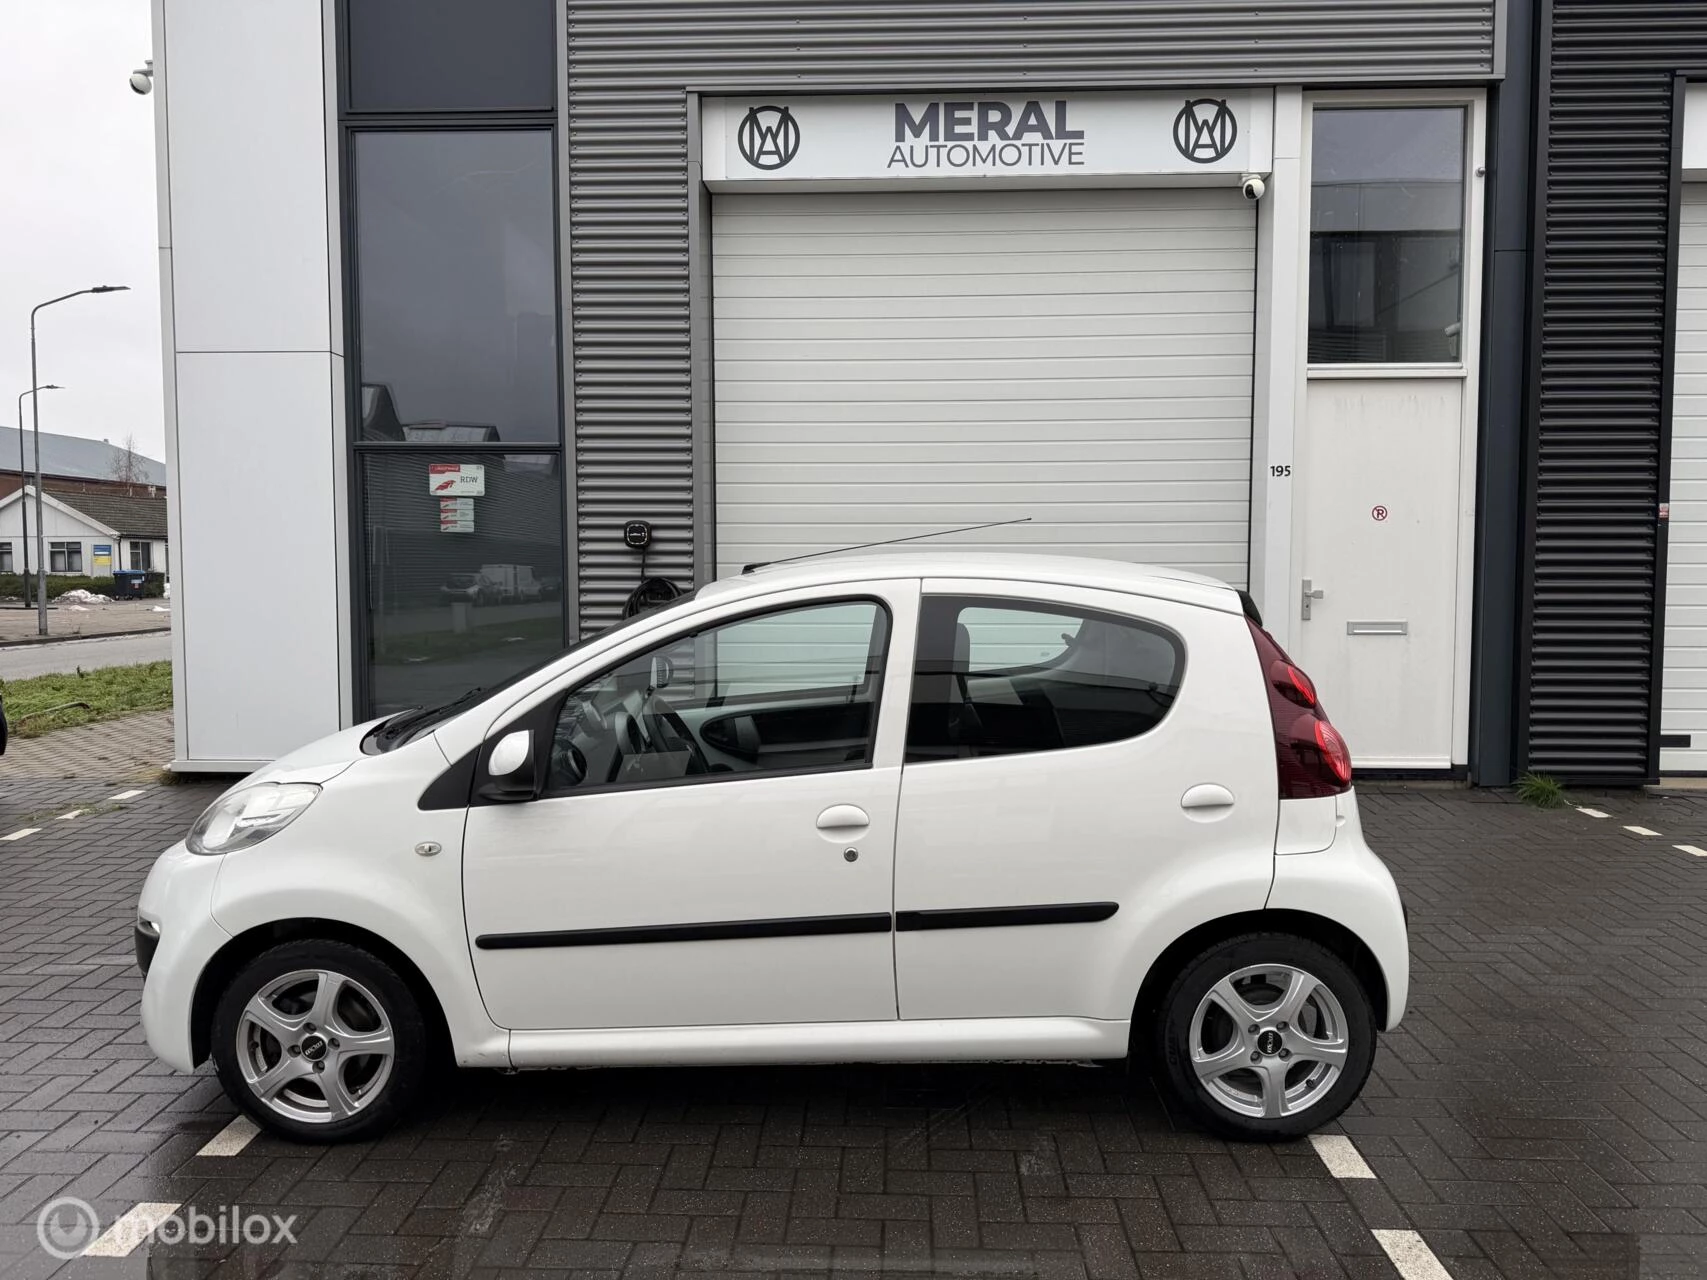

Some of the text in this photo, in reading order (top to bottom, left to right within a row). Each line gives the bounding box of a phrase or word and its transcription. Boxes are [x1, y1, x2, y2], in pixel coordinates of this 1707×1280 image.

[895, 100, 1085, 142] MERAL
[887, 142, 1085, 169] AUTOMOTIVE
[1270, 465, 1291, 477] 195
